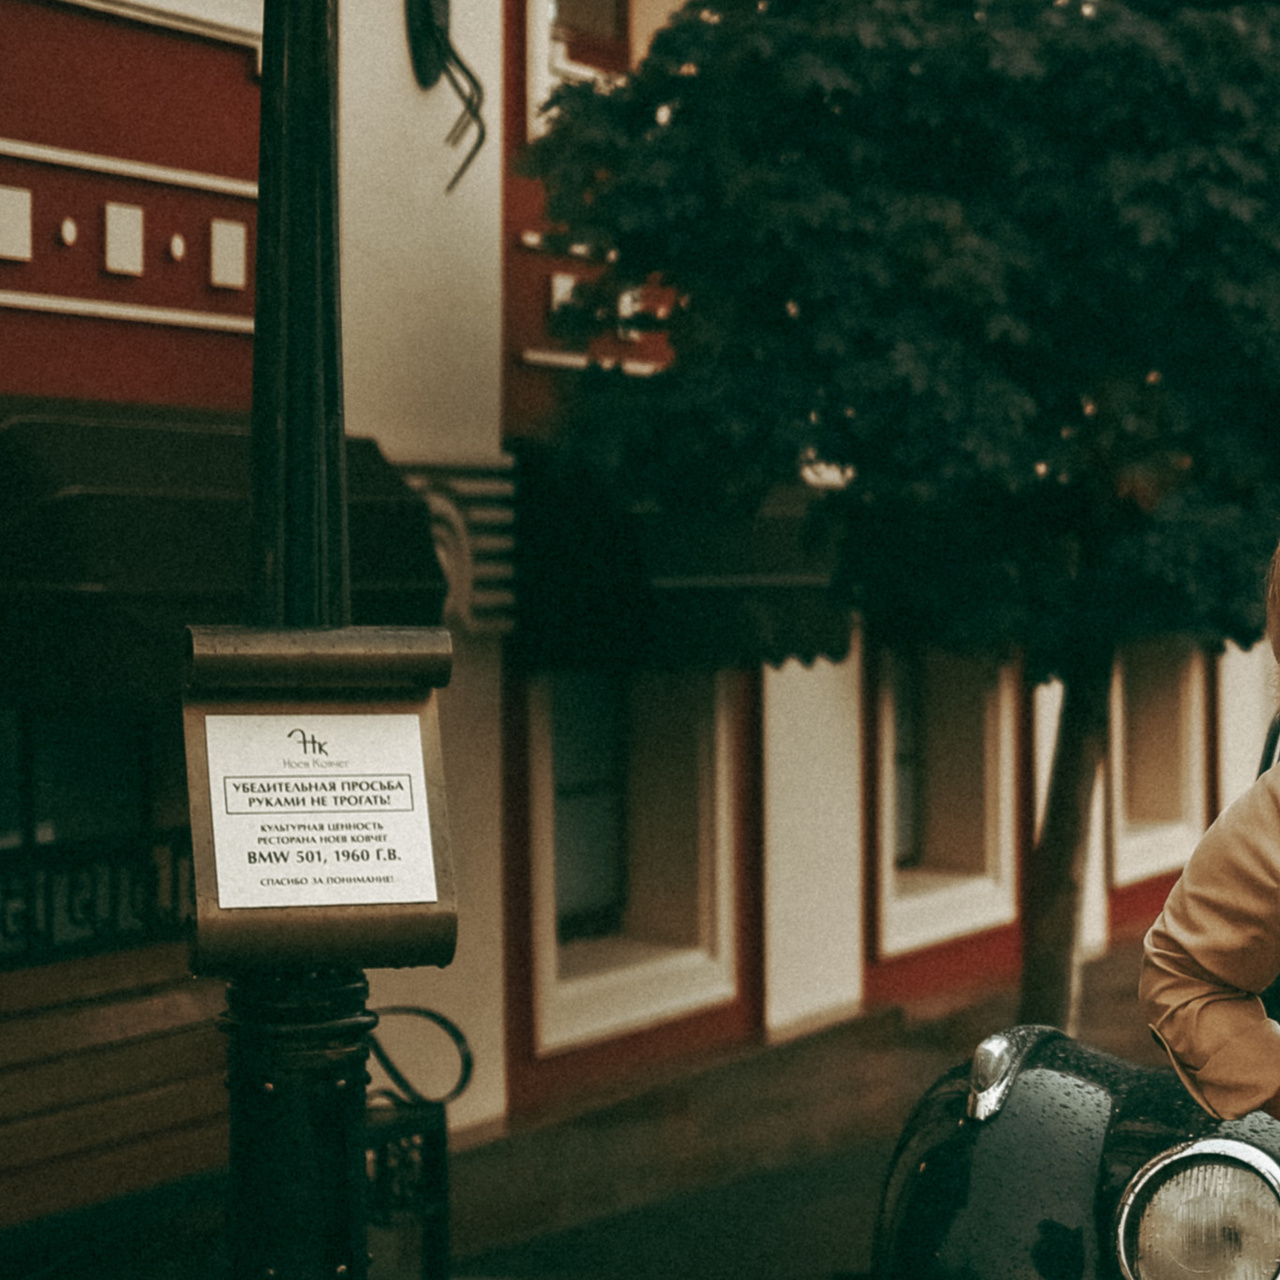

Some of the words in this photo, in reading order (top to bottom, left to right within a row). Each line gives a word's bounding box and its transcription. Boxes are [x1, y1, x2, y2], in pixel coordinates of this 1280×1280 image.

[232, 781, 337, 793] УБЕДИТЕЛЬНАЯ
[341, 780, 404, 792] ПРОСЬБА
[248, 796, 306, 808] РУКАМИ
[311, 796, 328, 807] НЕ
[333, 795, 391, 807] ТРОГАТЬ!
[260, 823, 324, 833] КУЛЬТУРНАЯ
[327, 822, 384, 831] ЦЕННОСТЬ
[257, 835, 317, 845] РЕСТОРАНА
[319, 835, 348, 844] НОЕВ
[351, 834, 388, 843] КОВЧЕГ
[247, 851, 290, 865] BMW
[296, 851, 328, 865] 501,
[335, 849, 370, 863] 1960
[376, 848, 402, 862] Г.В.
[259, 877, 308, 887] СПАСИБО
[311, 878, 324, 886] ЗА
[326, 876, 394, 886] ПОНИМАНИЕ!
